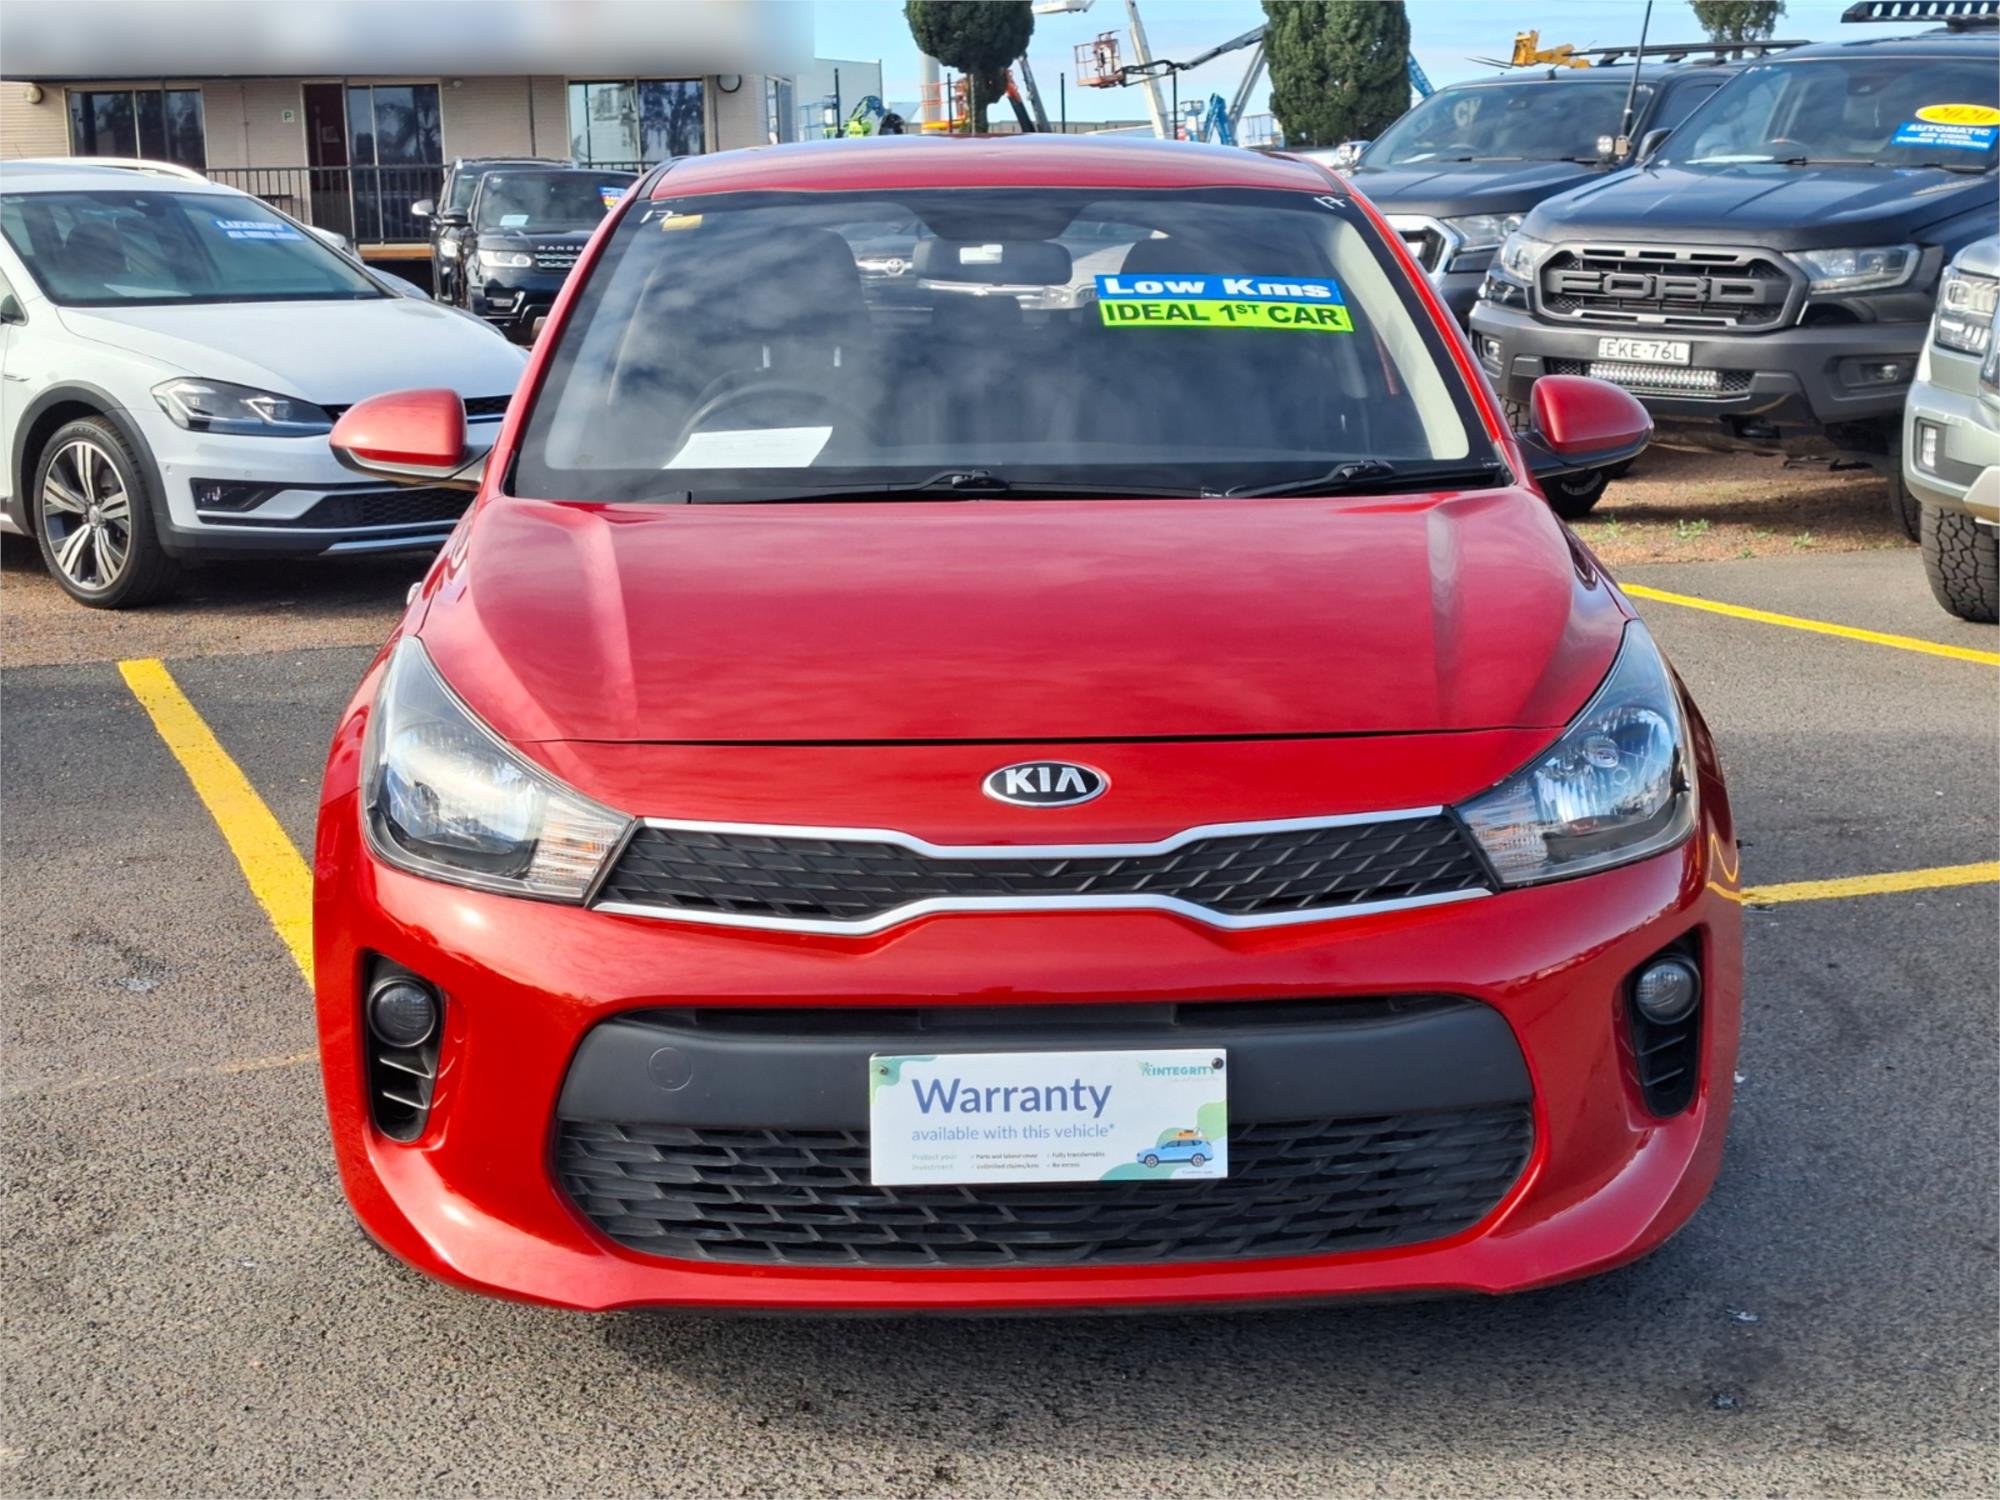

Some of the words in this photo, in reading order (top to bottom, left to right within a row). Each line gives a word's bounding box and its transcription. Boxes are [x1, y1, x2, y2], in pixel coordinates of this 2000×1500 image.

[1928, 107, 1995, 121] 2020
[1906, 123, 1991, 136] AUTOMATIC
[1103, 277, 1206, 295] Low
[1222, 278, 1332, 299] Kms
[1547, 269, 1766, 304] FORD
[1105, 303, 1211, 322] IDEAL
[1267, 305, 1343, 326] CAR
[1004, 766, 1088, 795] KIA
[1151, 1065, 1216, 1076] INTEGRITY
[911, 1077, 1112, 1119] Warranty
[911, 1126, 980, 1141] available
[983, 1125, 1018, 1140] with
[1023, 1124, 1050, 1139] this
